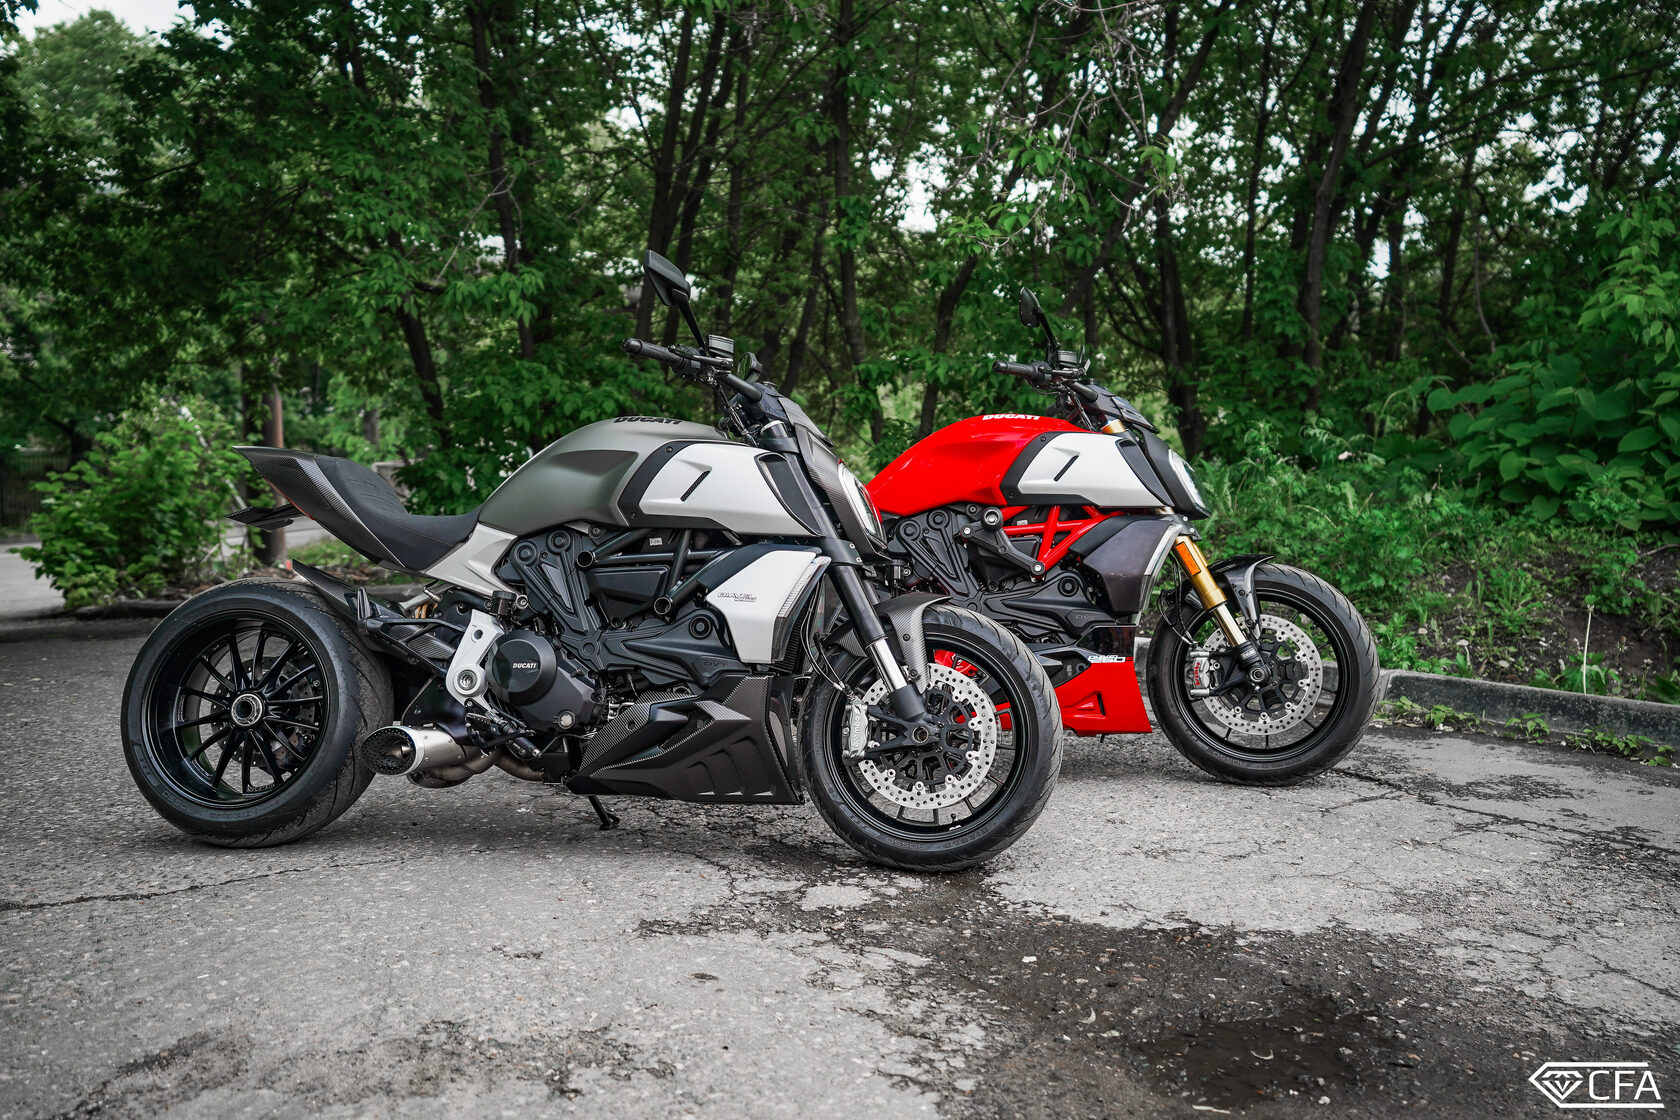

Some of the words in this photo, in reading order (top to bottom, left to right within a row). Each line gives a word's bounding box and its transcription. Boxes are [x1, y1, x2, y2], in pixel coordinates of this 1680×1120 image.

[613, 416, 682, 425] DUCATI
[982, 413, 1040, 421] DUCATI
[850, 716, 860, 747] brembo
